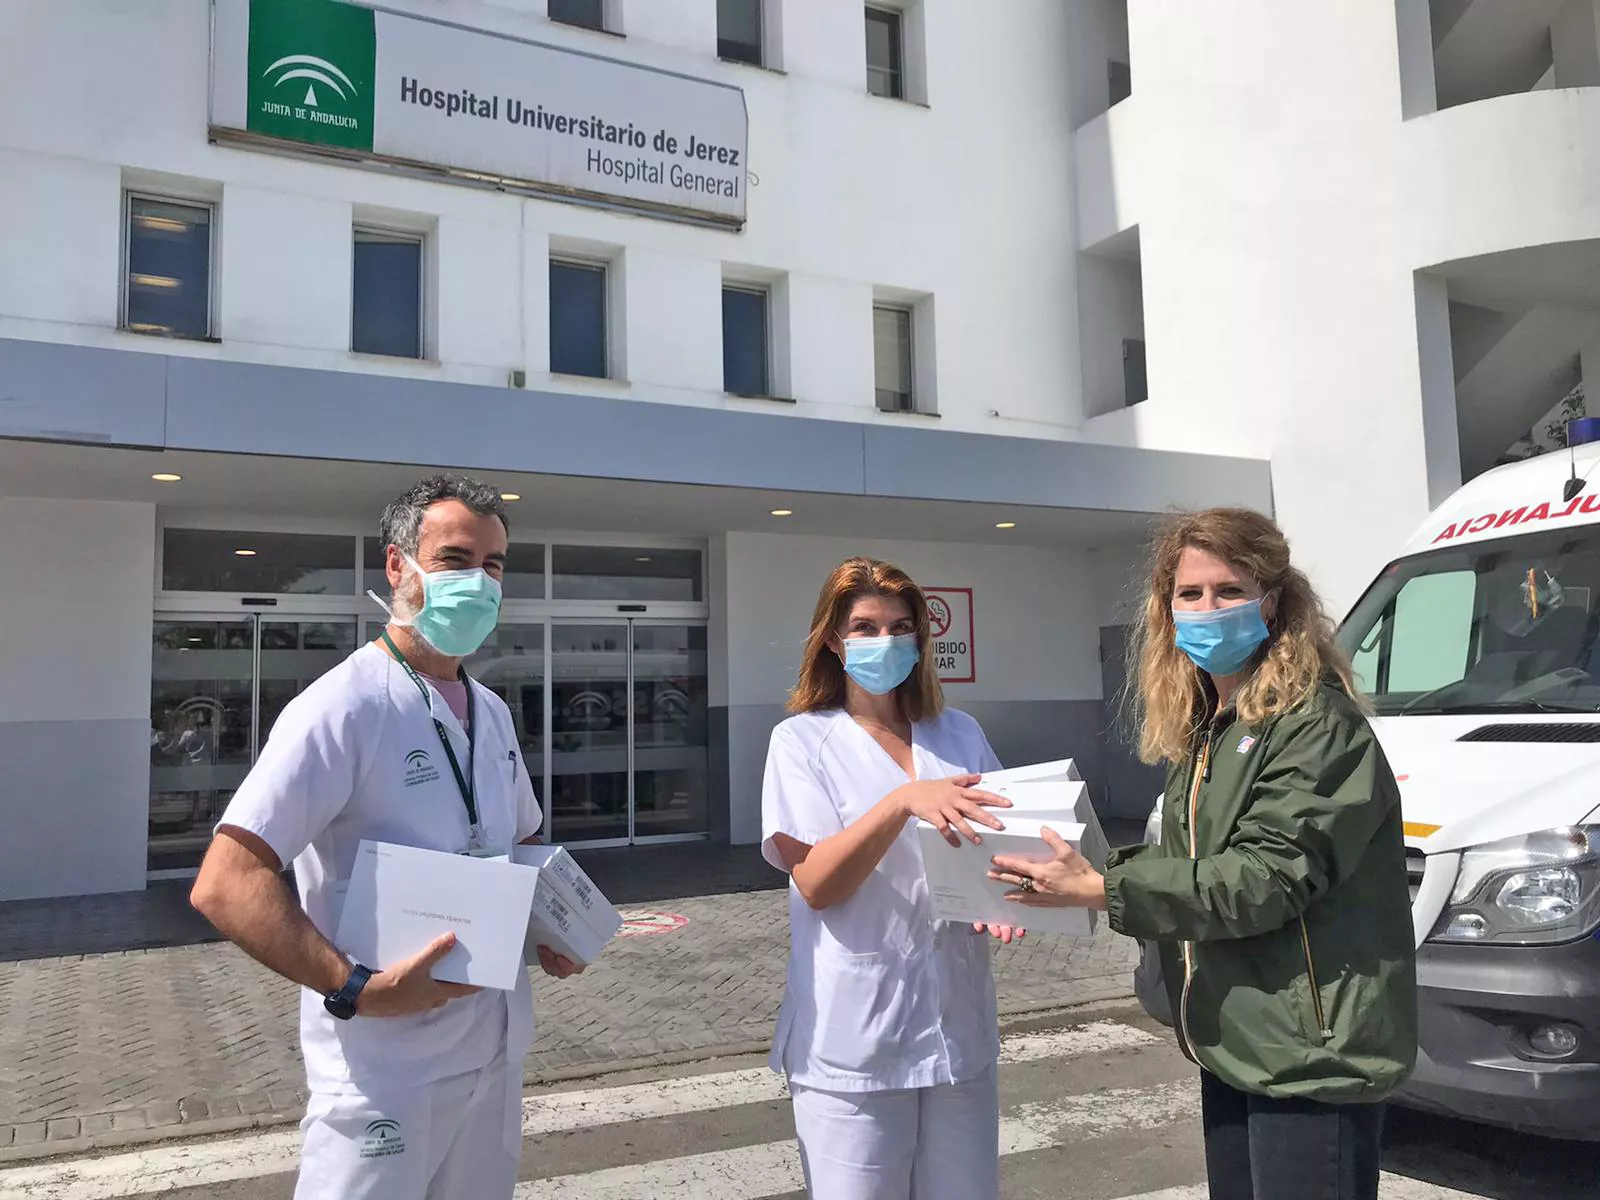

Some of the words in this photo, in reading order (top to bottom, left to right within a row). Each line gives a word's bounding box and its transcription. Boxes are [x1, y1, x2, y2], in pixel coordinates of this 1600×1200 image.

[261, 101, 291, 117] JUNTA
[295, 107, 307, 120] DE
[310, 110, 358, 129] ANDALUCIA
[400, 76, 499, 121] Hospital
[506, 99, 647, 149] Universitario
[652, 128, 678, 155] de
[683, 135, 740, 167] Jerez
[587, 148, 664, 185] Hospital
[669, 163, 739, 199] General
[932, 641, 967, 654] IBIDO
